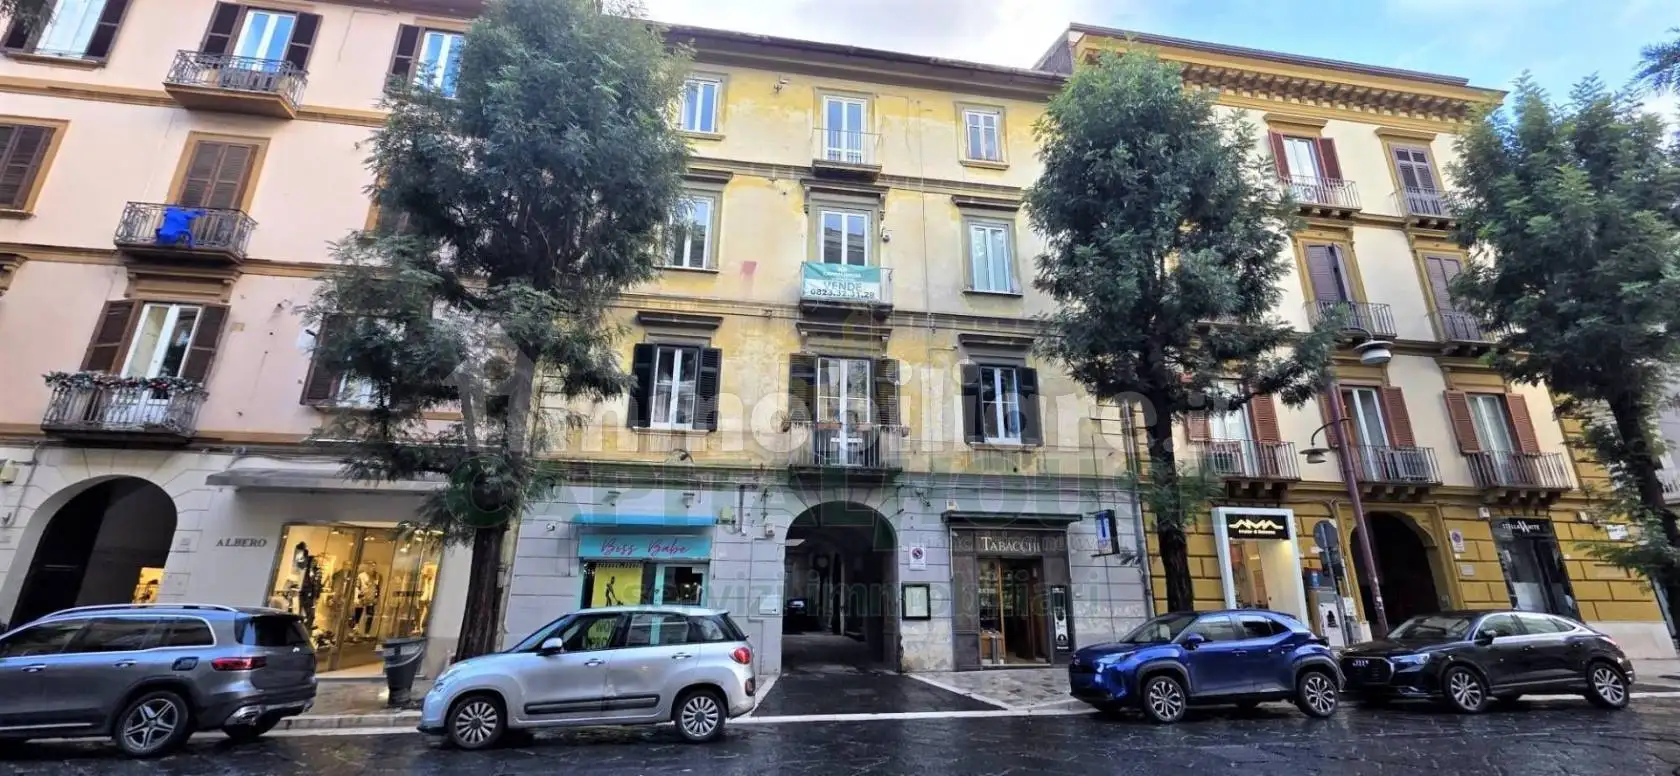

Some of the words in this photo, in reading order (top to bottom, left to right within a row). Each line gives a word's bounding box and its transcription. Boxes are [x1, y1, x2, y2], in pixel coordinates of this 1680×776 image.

[823, 280, 863, 293] VENDE
[215, 538, 268, 548] ALBERO
[981, 536, 1041, 553] TABACCHI
